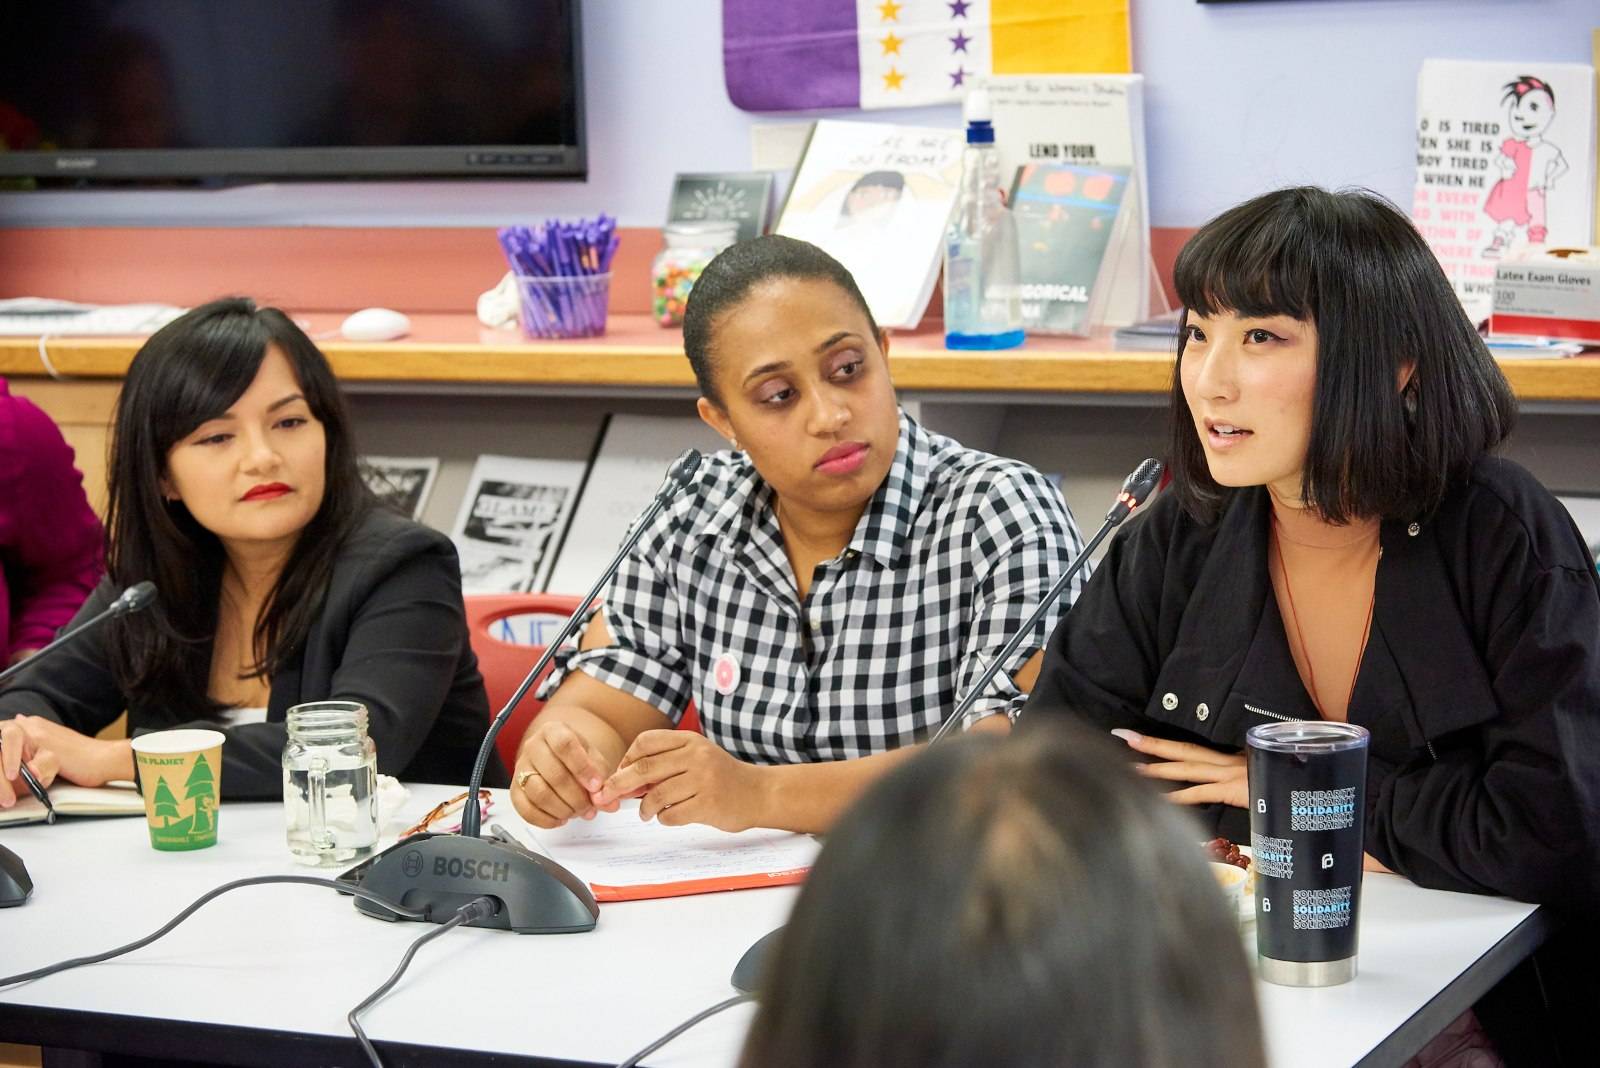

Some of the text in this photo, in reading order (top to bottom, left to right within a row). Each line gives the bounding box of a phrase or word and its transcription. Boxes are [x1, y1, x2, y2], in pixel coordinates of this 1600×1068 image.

[1439, 120, 1450, 132] IS
[1462, 122, 1500, 135] TIRED
[1029, 144, 1096, 158] LEND YOUR
[1417, 136, 1492, 153] EN SHE IS
[1451, 157, 1488, 170] TIRED
[1424, 174, 1485, 188] WHEN HE
[1497, 269, 1591, 286] Latex Exam Gloves
[149, 757, 185, 766] PLANET
[1291, 803, 1354, 815] SOLIDARITY
[433, 856, 509, 881] BOSCH
[1293, 902, 1350, 914] SOLIDARITY
